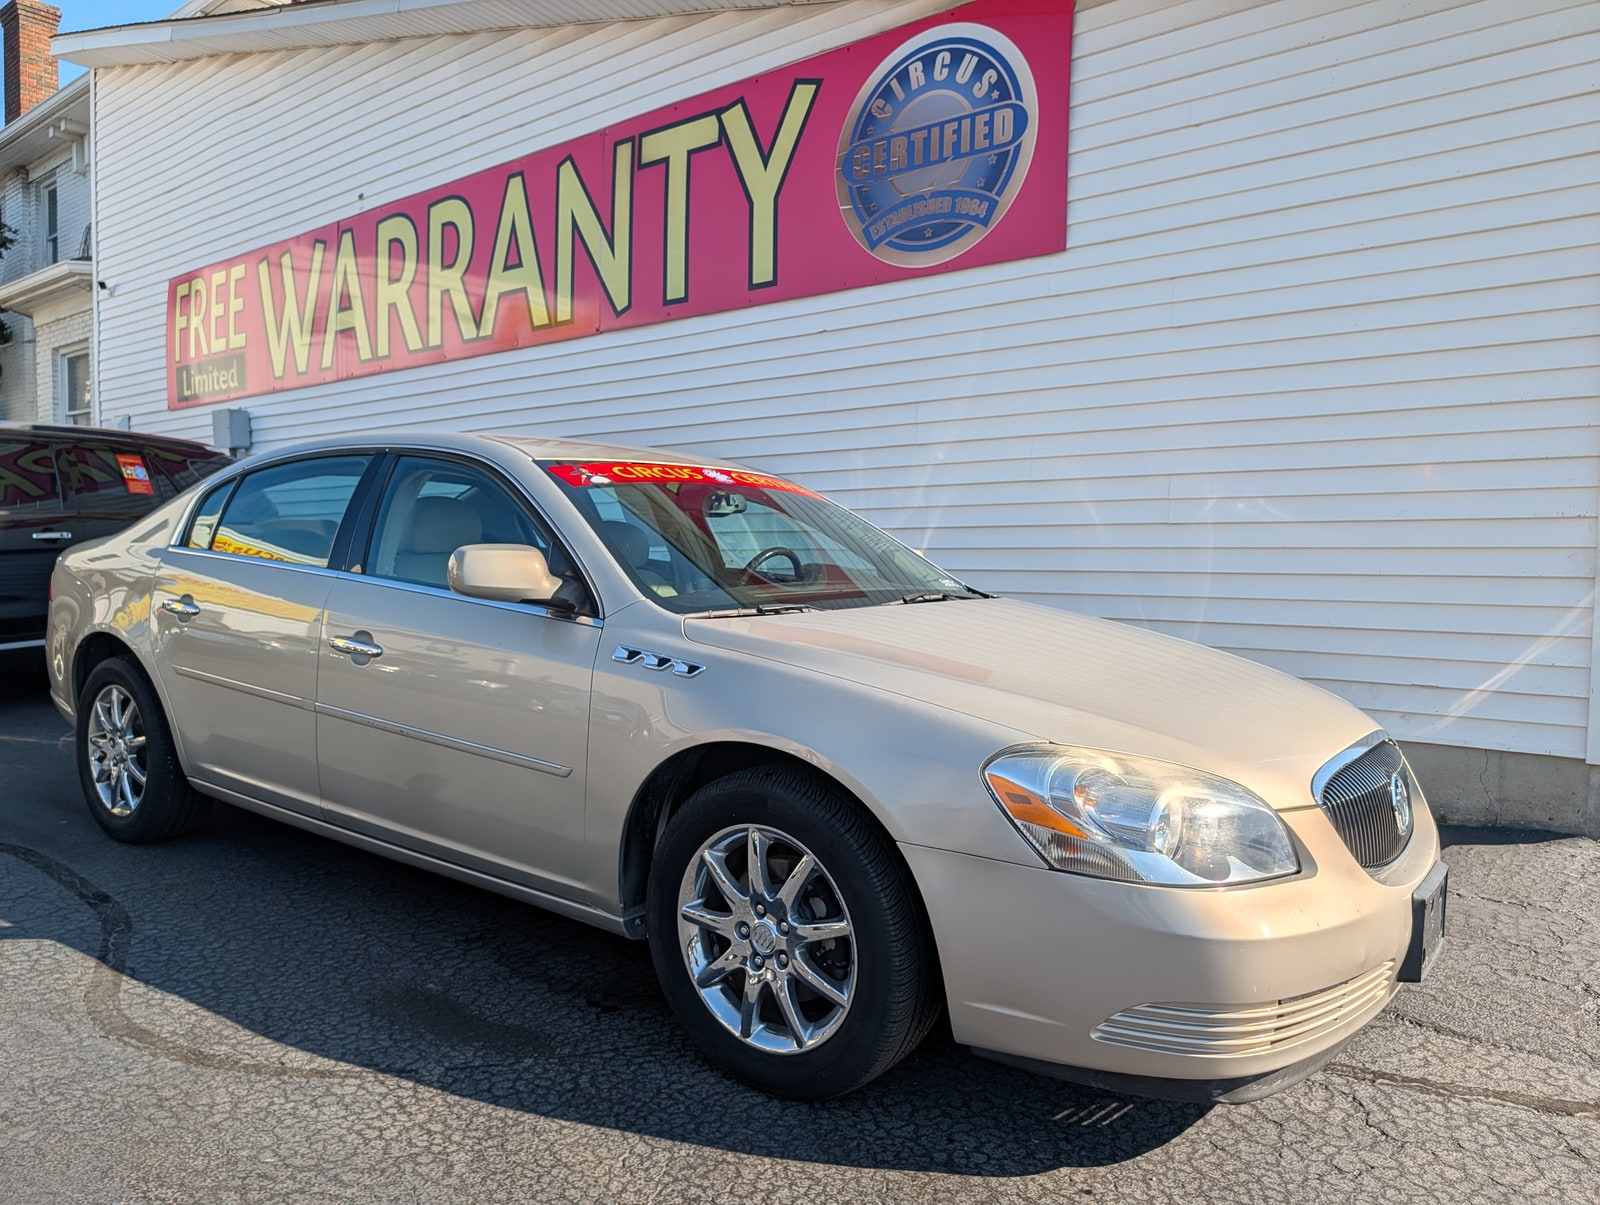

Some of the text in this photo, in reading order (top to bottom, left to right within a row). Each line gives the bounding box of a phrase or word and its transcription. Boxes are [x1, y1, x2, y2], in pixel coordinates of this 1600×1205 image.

[871, 51, 998, 121] CIRCUS
[852, 107, 1015, 179] CERTIFIED
[174, 78, 824, 380] FREE WARRANTY
[869, 196, 953, 240] ESTABLISHED
[182, 358, 239, 397] Limited
[611, 466, 704, 480] CIRCUS
